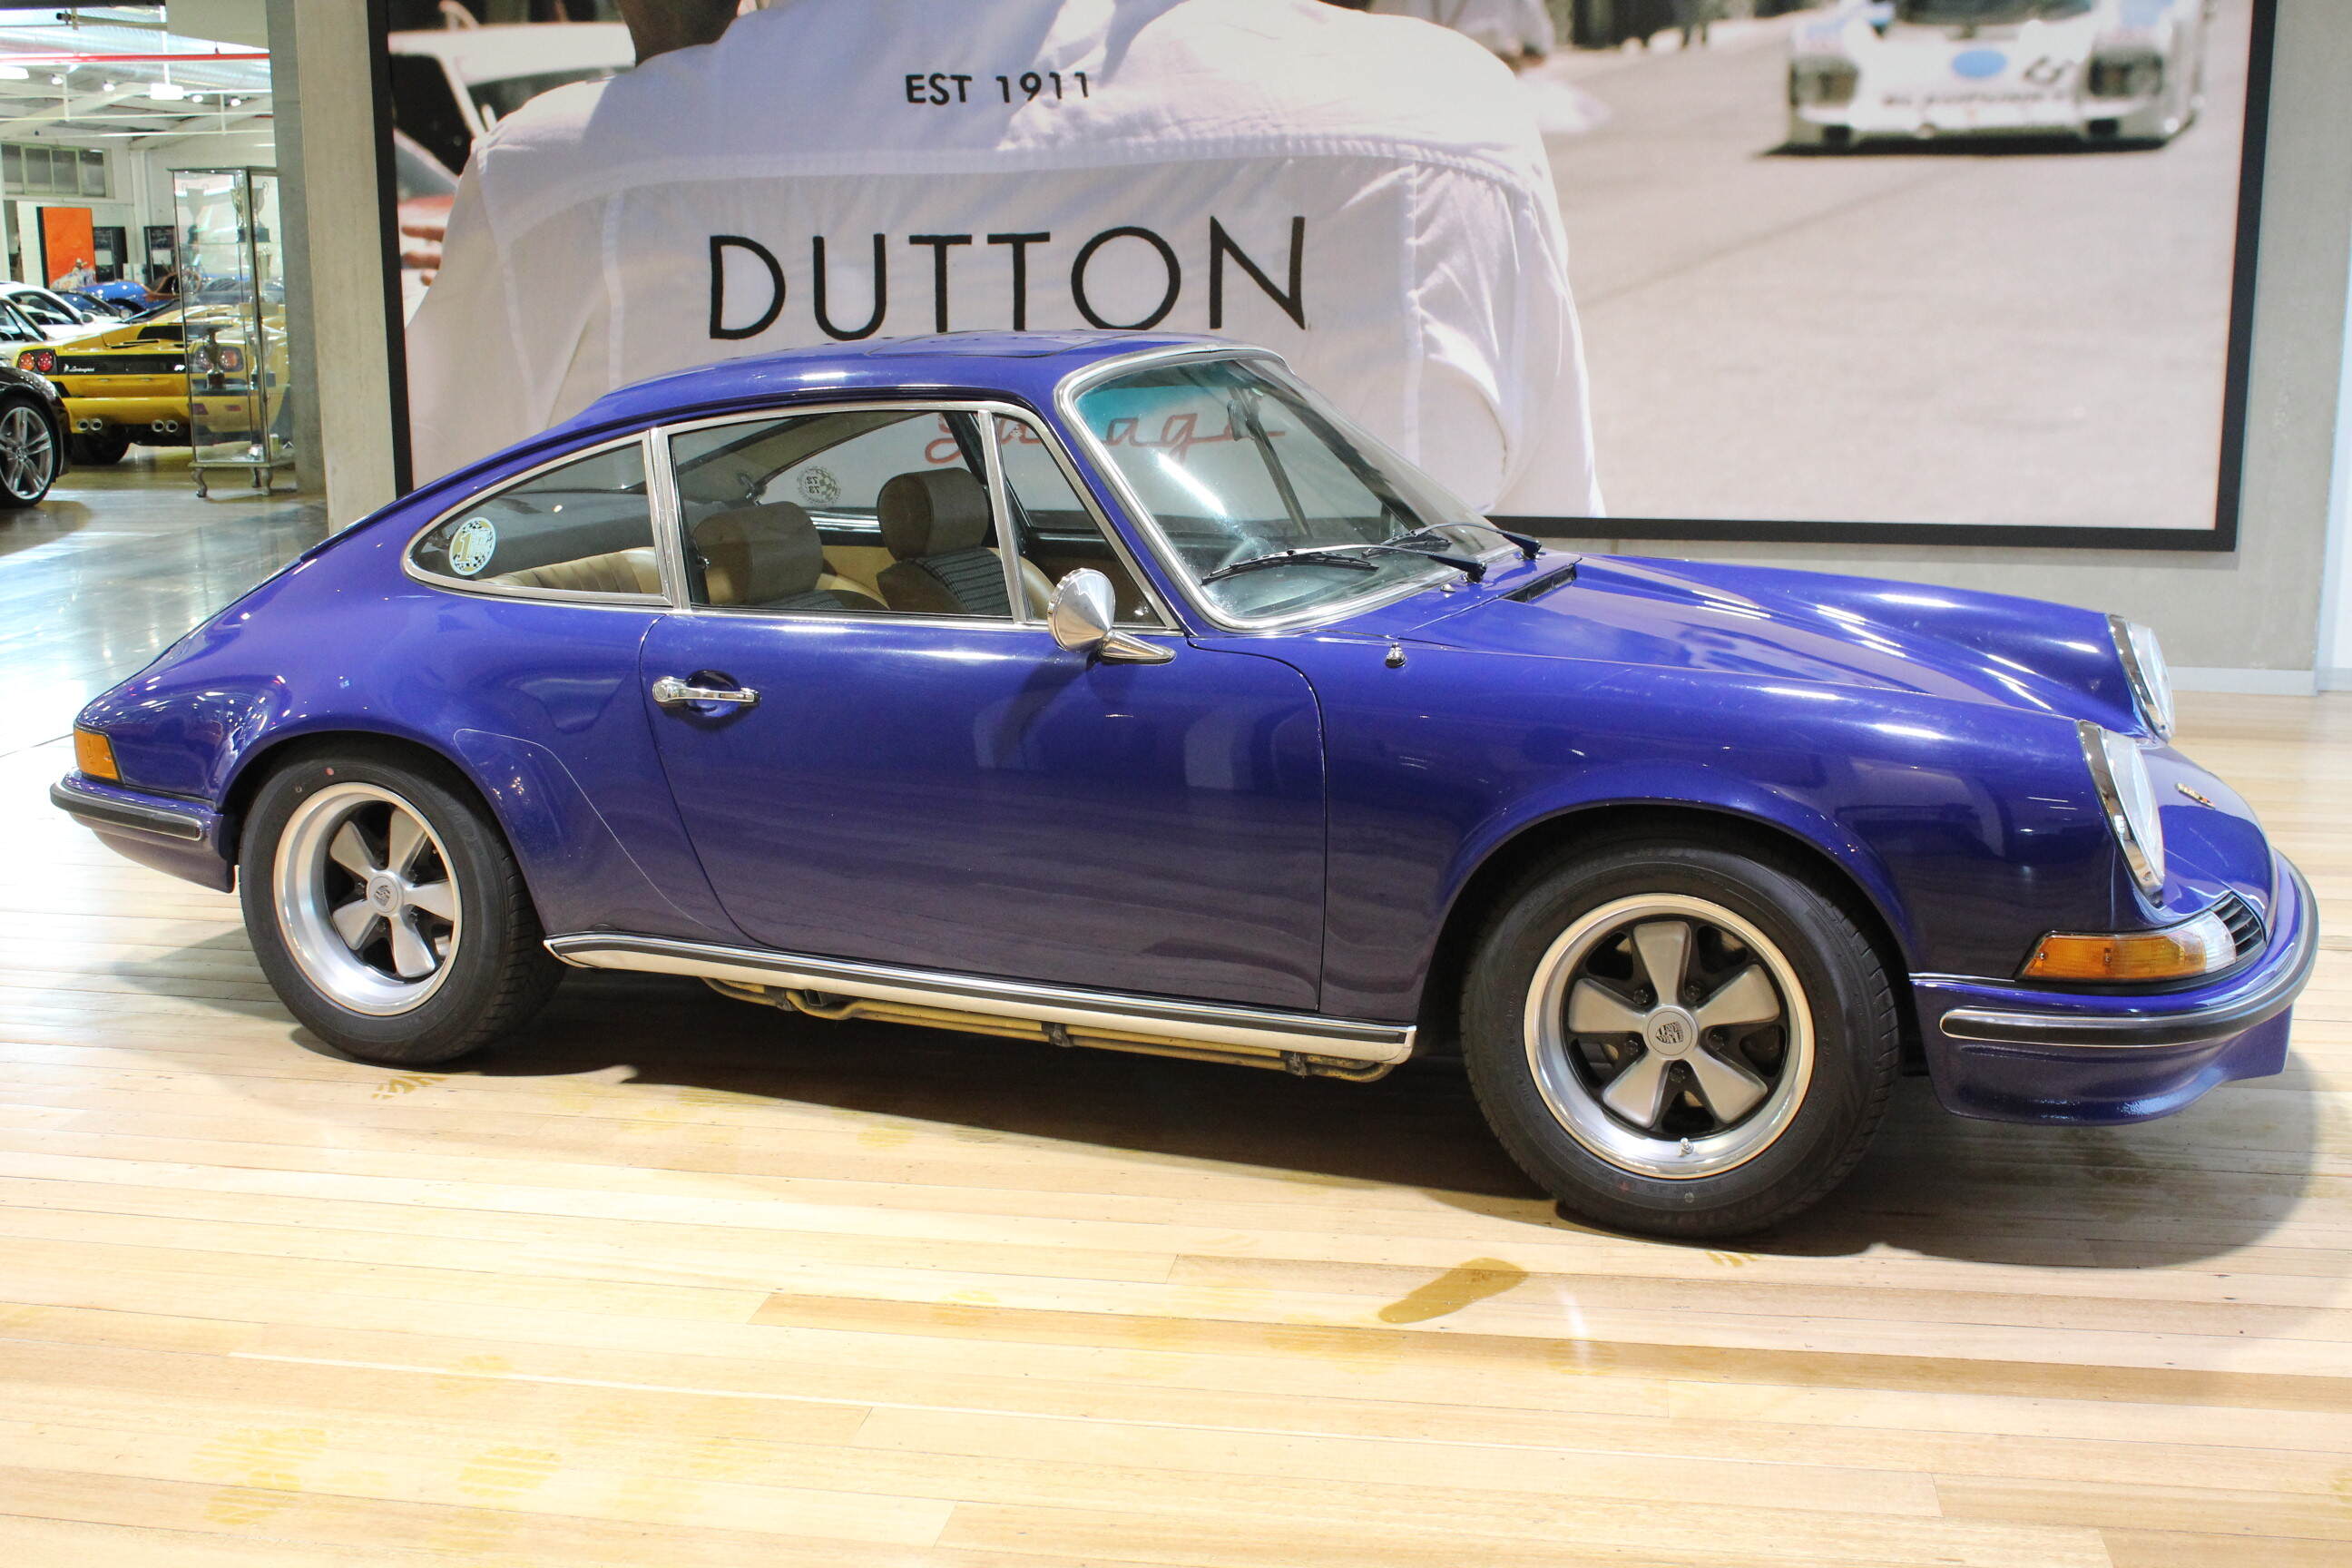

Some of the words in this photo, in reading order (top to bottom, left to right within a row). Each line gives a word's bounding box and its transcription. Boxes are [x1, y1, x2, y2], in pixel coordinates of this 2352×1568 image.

[906, 73, 973, 105] EST
[995, 72, 1089, 103] 1911
[709, 216, 1307, 341] DUTTON
